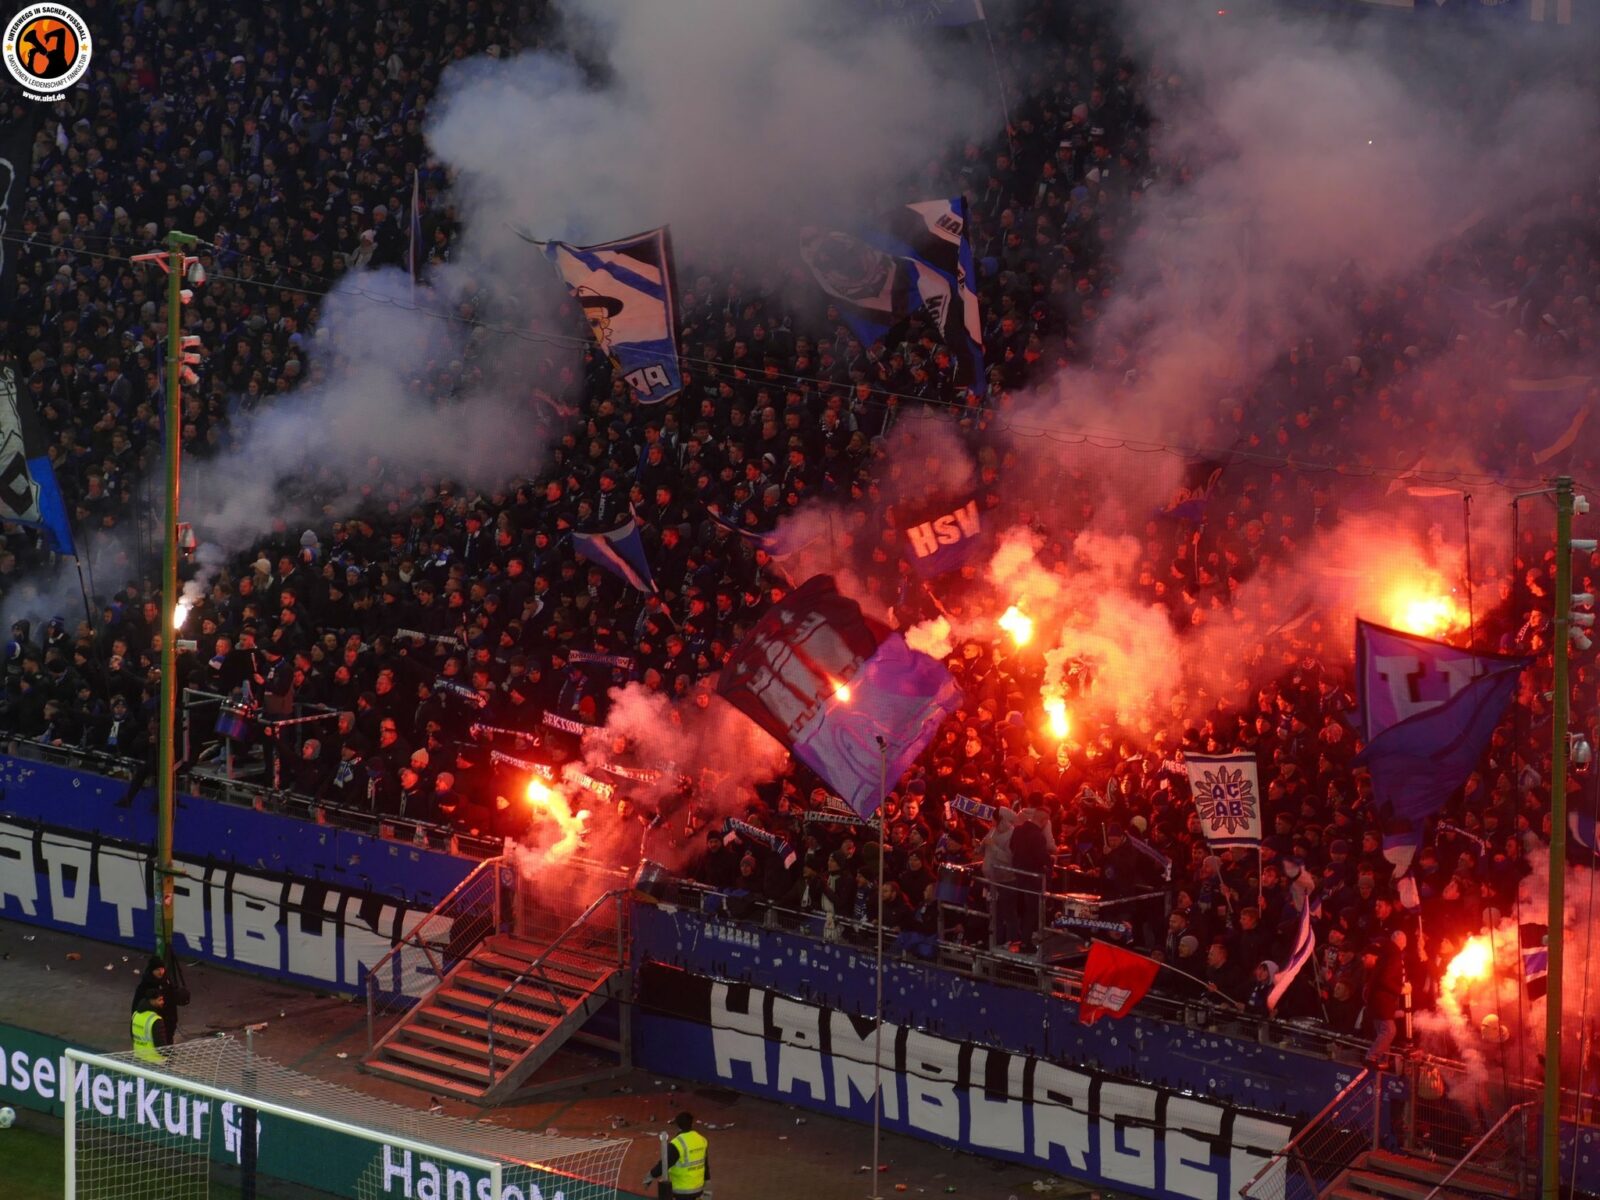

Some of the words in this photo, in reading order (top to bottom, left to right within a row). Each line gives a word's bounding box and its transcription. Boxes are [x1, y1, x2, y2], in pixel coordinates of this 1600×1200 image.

[906, 499, 980, 558] HSV
[542, 710, 584, 736] SEKTION
[1212, 783, 1240, 799] AC
[1215, 800, 1243, 817] AB
